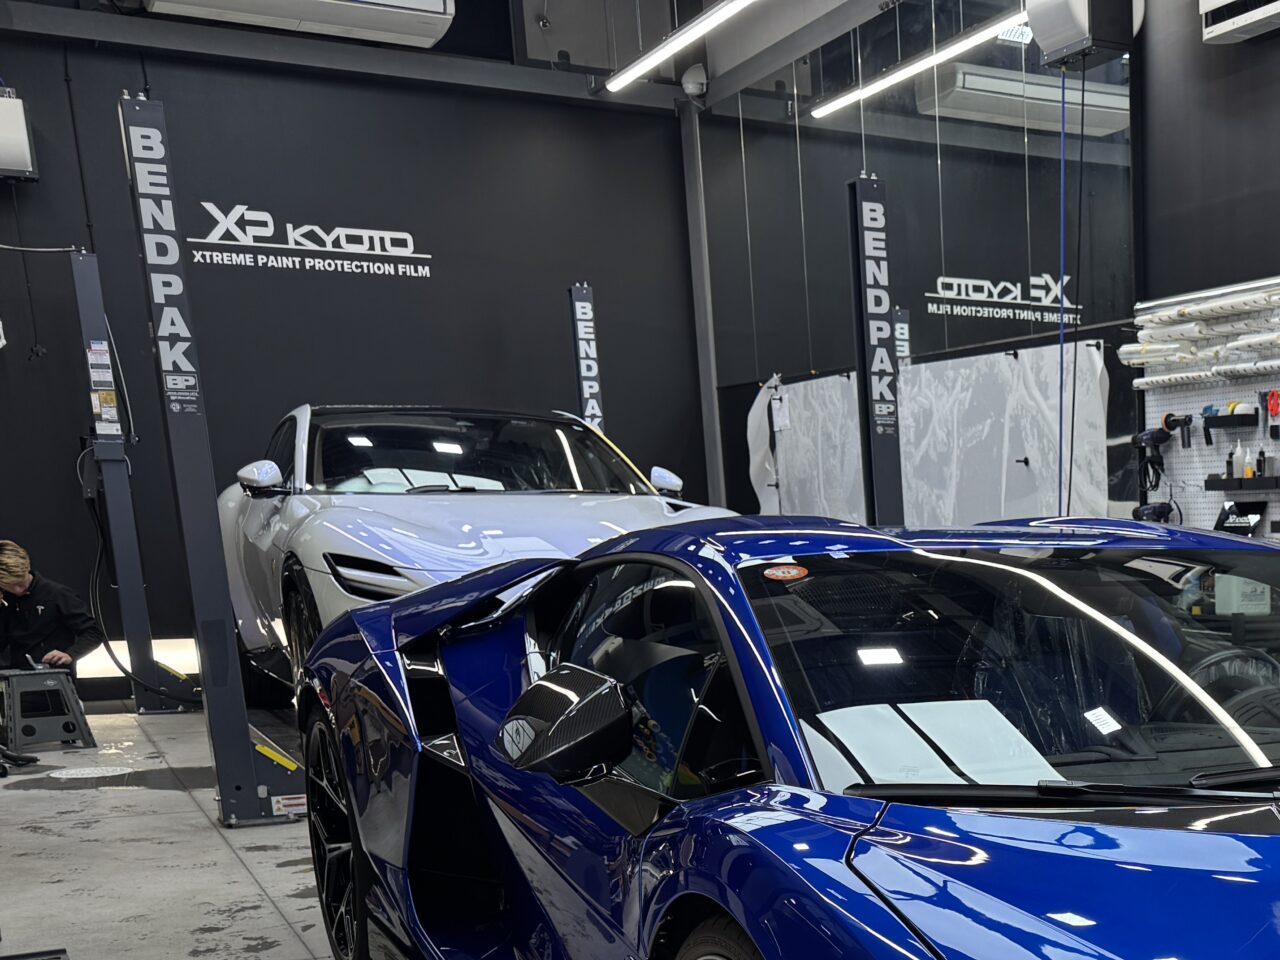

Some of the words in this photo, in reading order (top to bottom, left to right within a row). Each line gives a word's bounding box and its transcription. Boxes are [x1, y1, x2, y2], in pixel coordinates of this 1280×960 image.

[129, 126, 196, 372] BENDPAK
[200, 201, 275, 245] XP
[286, 223, 414, 255] KYOTO
[192, 250, 254, 266] XTREME
[258, 255, 301, 270] PAINT
[305, 258, 395, 276] PROTECTION
[398, 264, 430, 278] FILM
[862, 201, 896, 401] BENDPAK
[165, 375, 196, 389] BP
